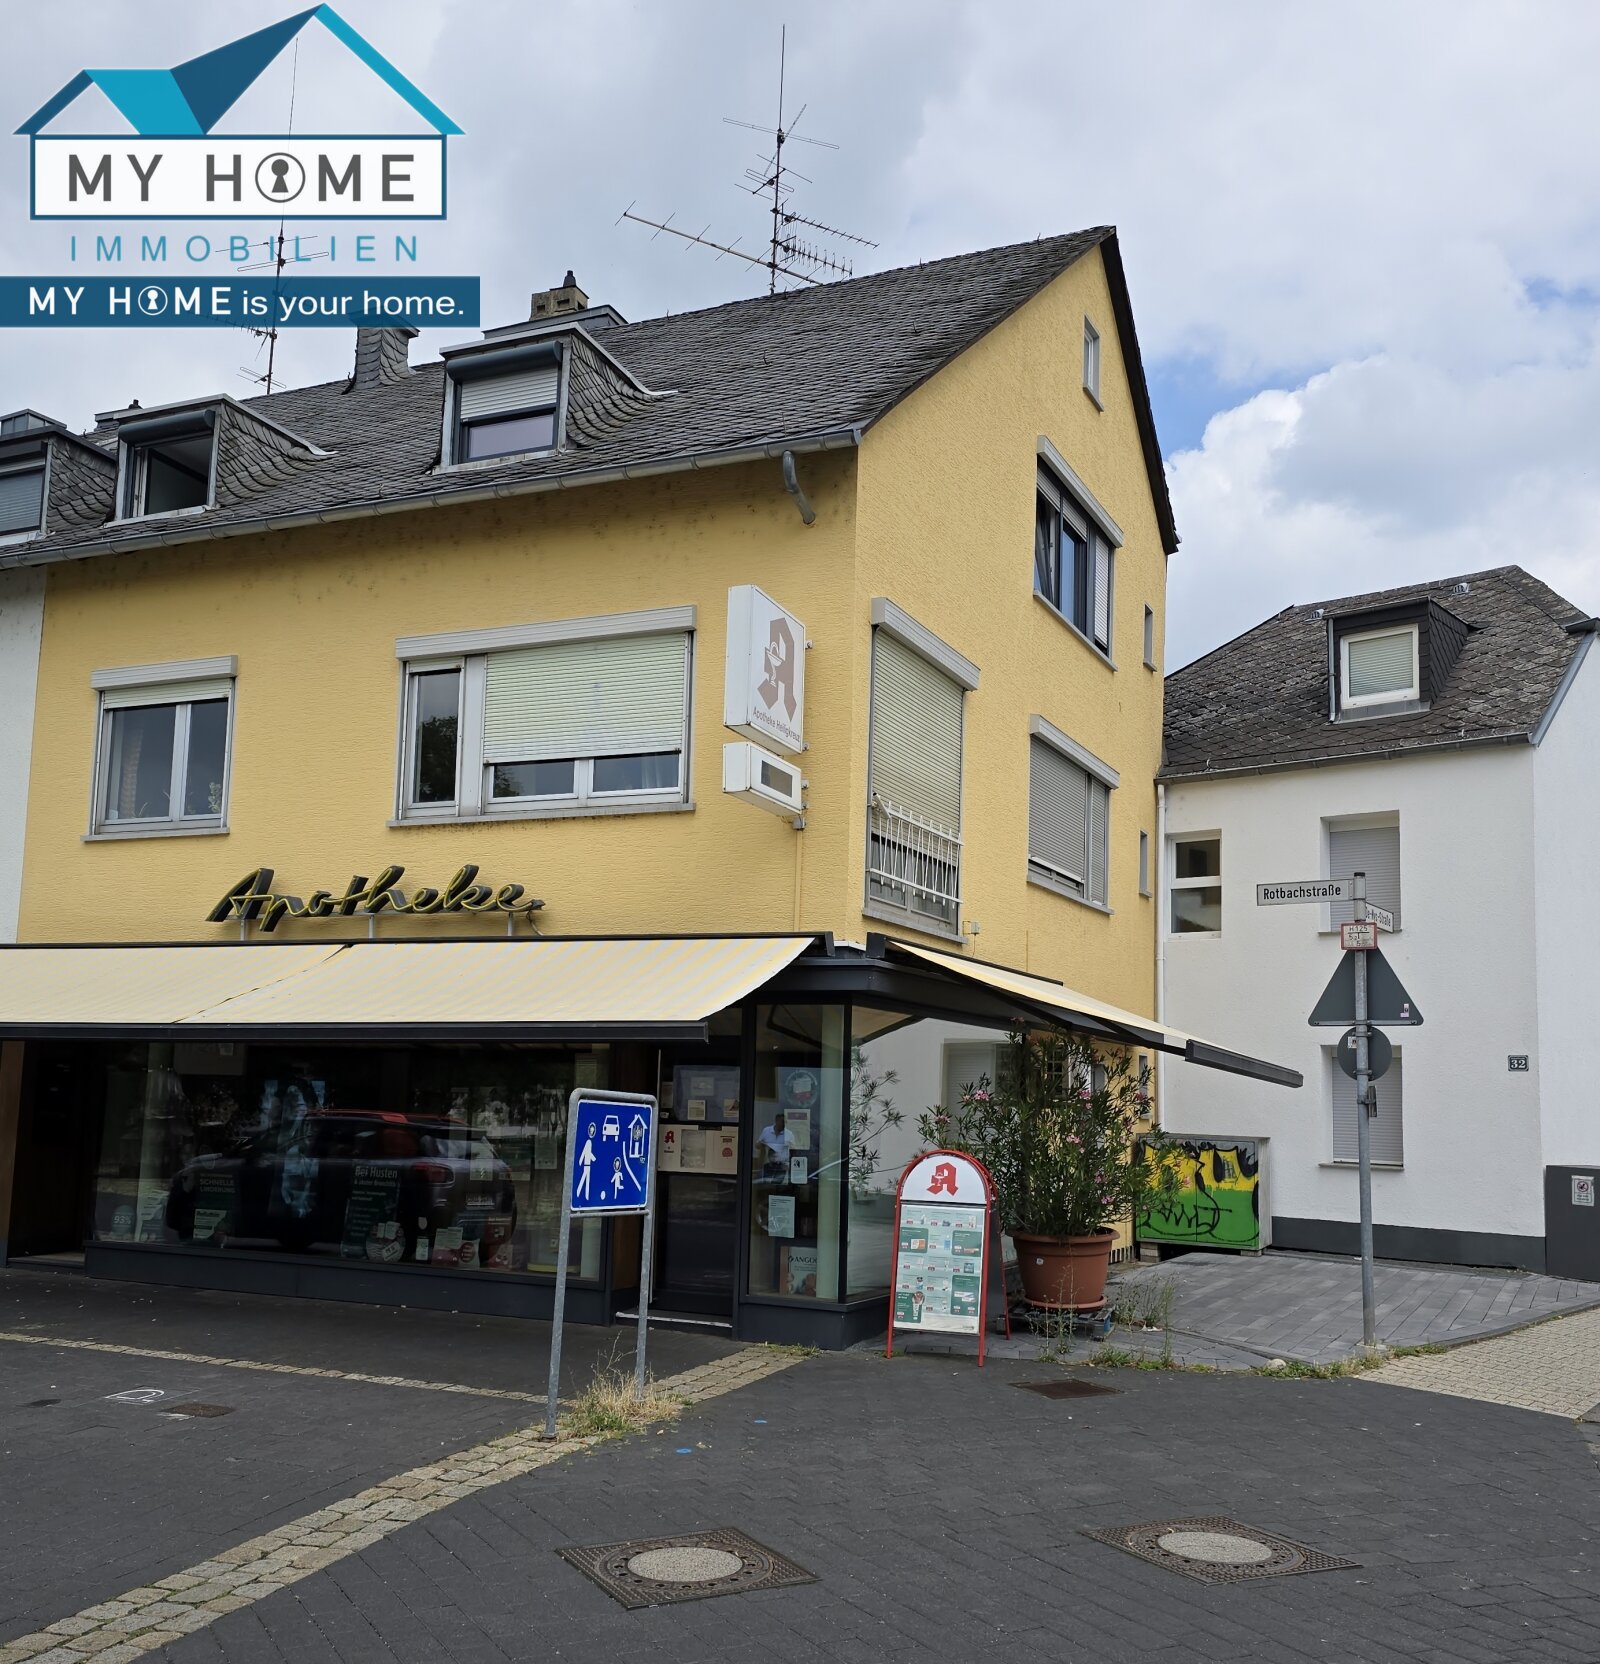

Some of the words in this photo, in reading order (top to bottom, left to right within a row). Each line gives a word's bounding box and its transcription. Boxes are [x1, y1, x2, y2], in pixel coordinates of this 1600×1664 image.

[752, 706, 776, 728] Apotheke
[204, 864, 546, 933] Apotheke
[1263, 884, 1341, 900] Rotbachstraße
[1510, 1059, 1526, 1069] 32
[354, 1166, 369, 1177] Bei
[370, 1167, 398, 1179] Husten
[113, 1215, 132, 1225] 93%
